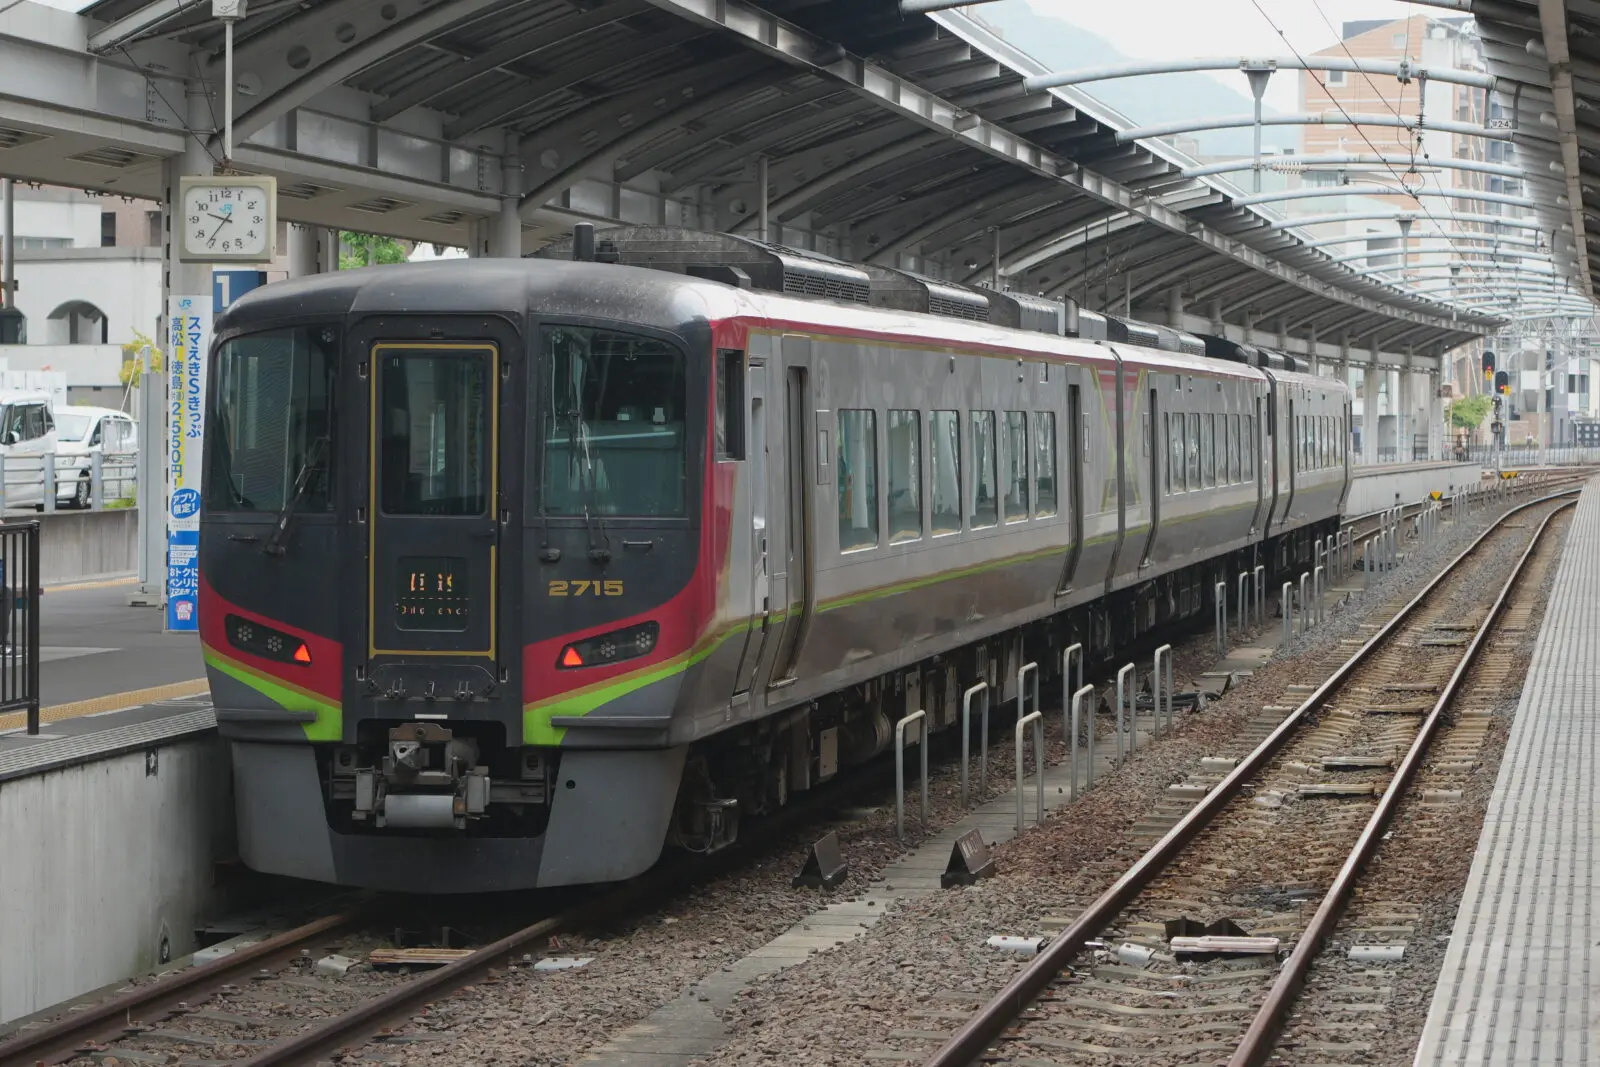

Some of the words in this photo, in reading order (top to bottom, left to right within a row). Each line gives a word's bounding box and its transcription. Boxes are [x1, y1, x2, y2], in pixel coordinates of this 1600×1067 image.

[209, 194, 218, 202] 11
[221, 190, 232, 198] 12
[236, 193, 241, 201] 1
[198, 203, 208, 211] 10
[218, 204, 233, 214] JR
[247, 202, 255, 210] 2
[191, 215, 200, 224] 9
[253, 215, 260, 224] 3
[197, 230, 205, 238] 8
[247, 230, 254, 238] 4
[209, 238, 216, 247] 7
[222, 241, 230, 249] 6
[235, 238, 242, 247] 5
[216, 275, 230, 307] 1
[178, 299, 192, 309] JR
[186, 316, 202, 438] スマえきSきっぷ
[173, 492, 197, 505] アプリ
[174, 502, 196, 515] 限定!
[548, 580, 624, 596] 2715
